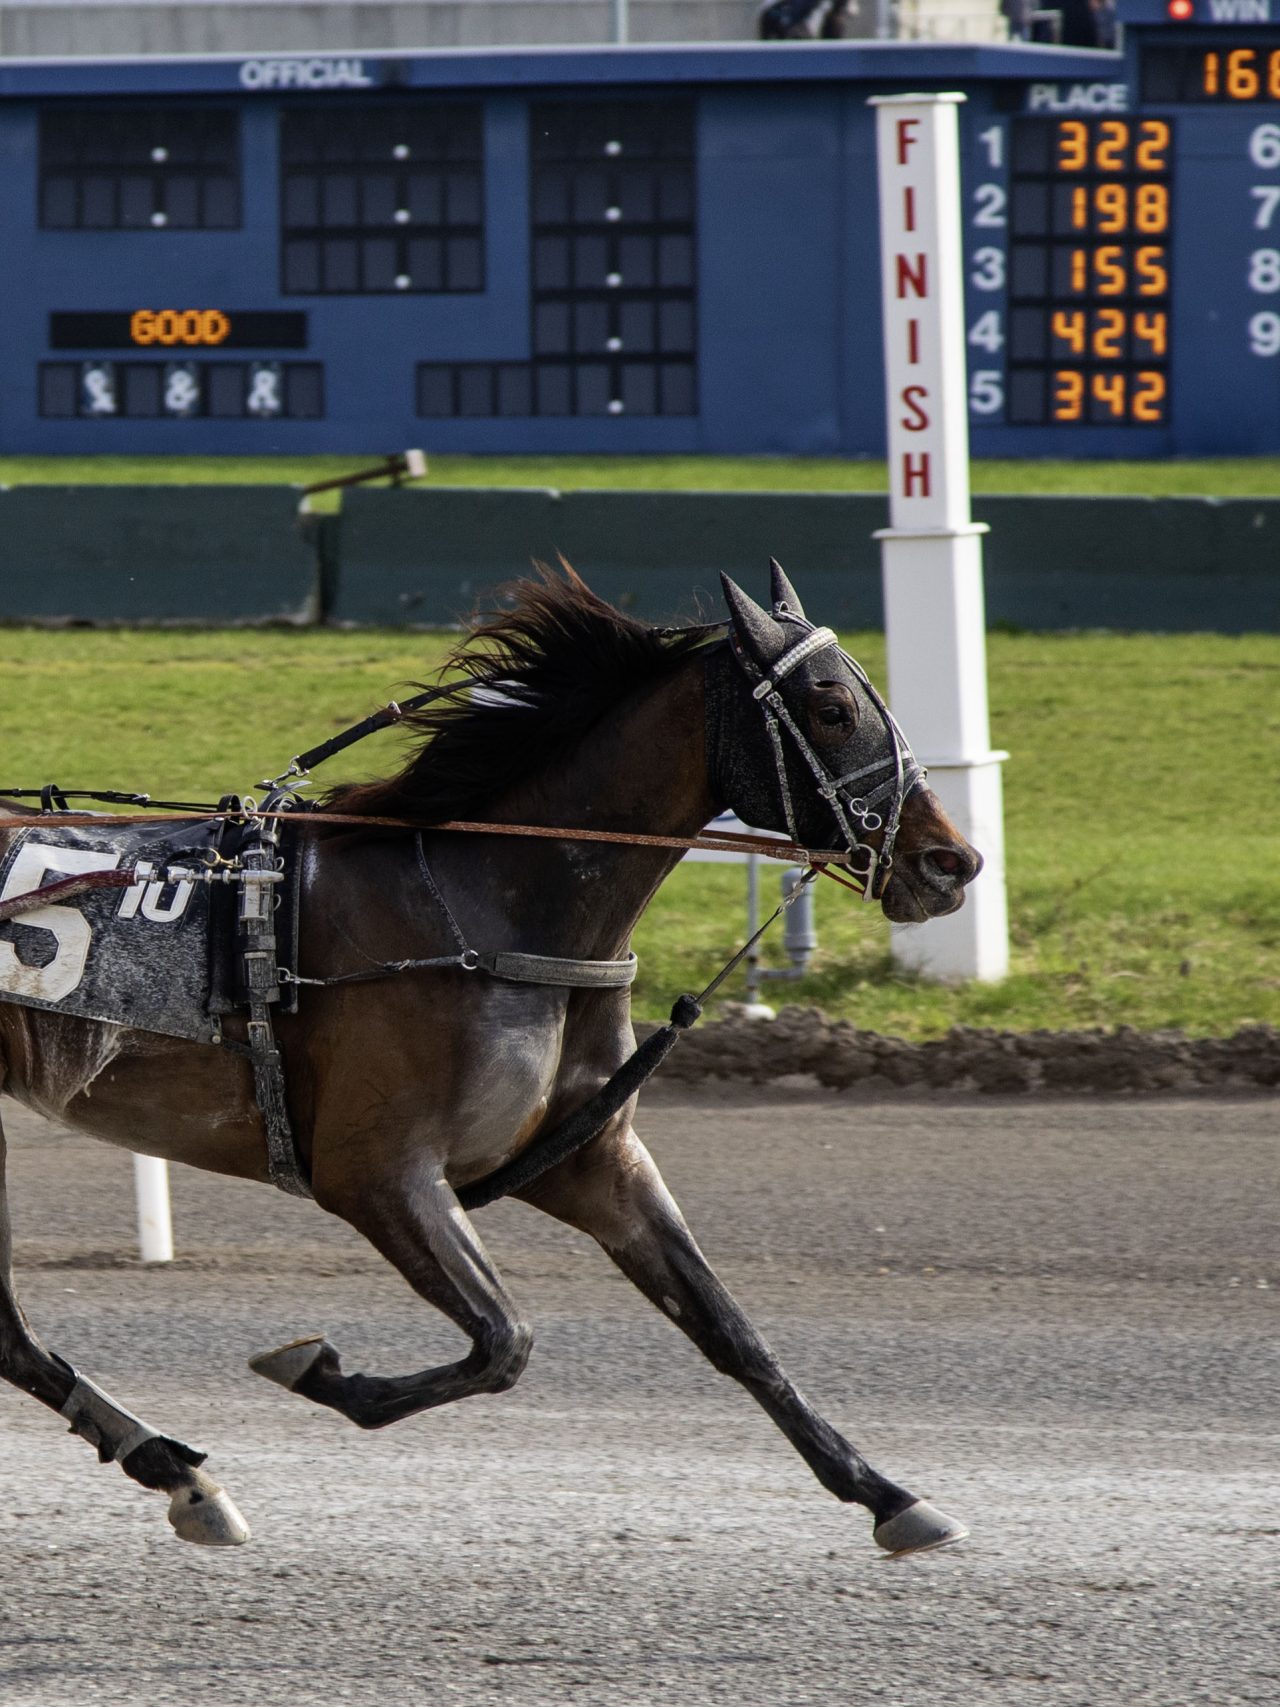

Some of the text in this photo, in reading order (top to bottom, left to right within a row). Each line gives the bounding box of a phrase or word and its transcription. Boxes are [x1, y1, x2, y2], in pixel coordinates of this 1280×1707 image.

[1209, 0, 1271, 22] WIN
[240, 60, 373, 88] OFFICIAL
[1030, 84, 1128, 112] PLACE
[979, 127, 1003, 168] 1
[1057, 120, 1170, 171] 322
[1248, 123, 1280, 169] 6
[973, 185, 1006, 227] 2
[1072, 183, 1168, 233] 198
[1249, 185, 1280, 229] 7
[972, 247, 1005, 291] 3
[1071, 245, 1167, 296] 155
[1248, 249, 1280, 294] 8
[129, 309, 232, 345] GOOD
[895, 119, 931, 498] FINISH
[969, 311, 1004, 353] 4
[1052, 309, 1167, 358] 424
[1248, 311, 1280, 356] 9
[970, 371, 1004, 414] 5
[1054, 371, 1166, 421] 342
